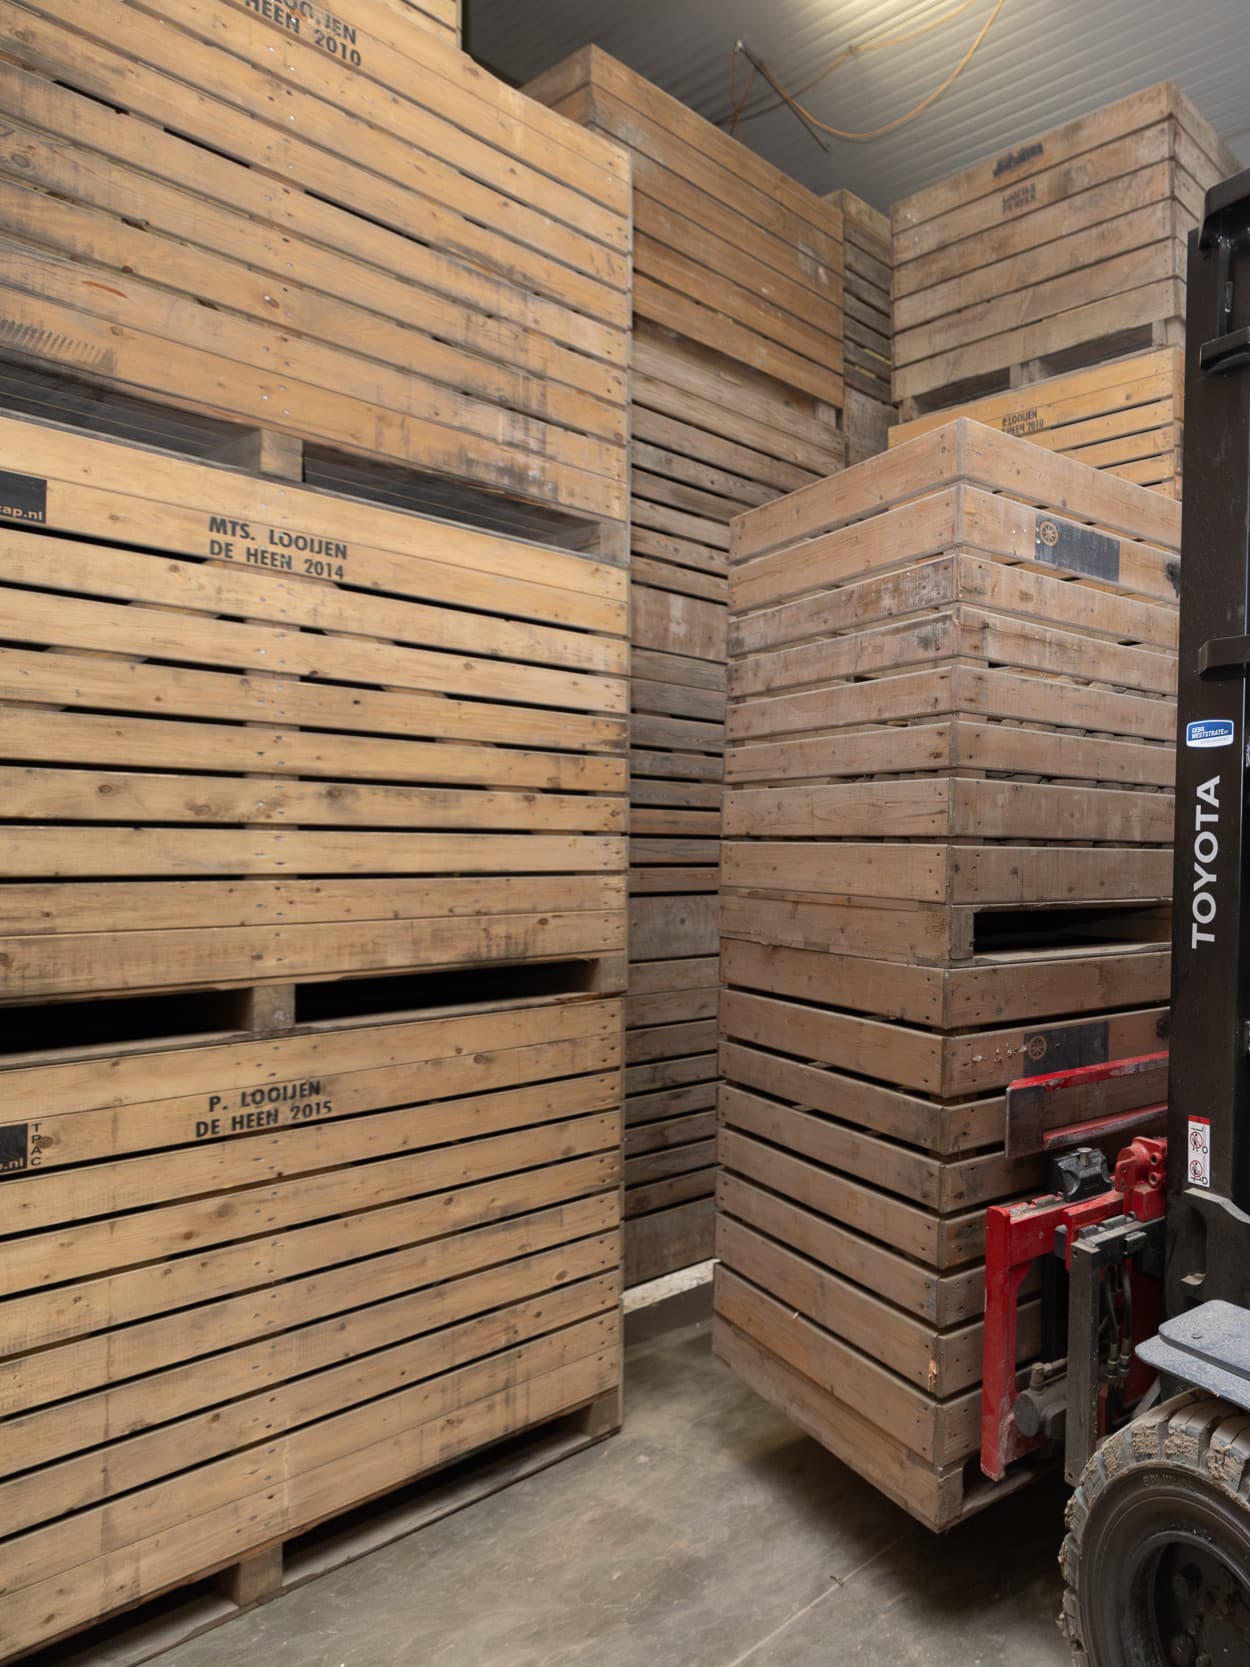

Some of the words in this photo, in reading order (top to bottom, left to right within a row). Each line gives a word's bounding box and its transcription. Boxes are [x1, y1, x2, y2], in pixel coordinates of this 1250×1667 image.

[314, 28, 362, 66] 2010
[0, 505, 43, 521] ap.nl
[209, 515, 256, 541] MTS.
[269, 529, 347, 560] LOOIJEN
[209, 539, 233, 559] DE
[246, 547, 292, 570] HEEN
[304, 558, 344, 580] 2014
[1191, 775, 1221, 950] TOYOTA
[209, 1096, 228, 1112] P.
[241, 1081, 321, 1108] LOOIJEN
[195, 1118, 221, 1138] DE
[231, 1108, 279, 1132] HEEN
[290, 1100, 332, 1120] 2015
